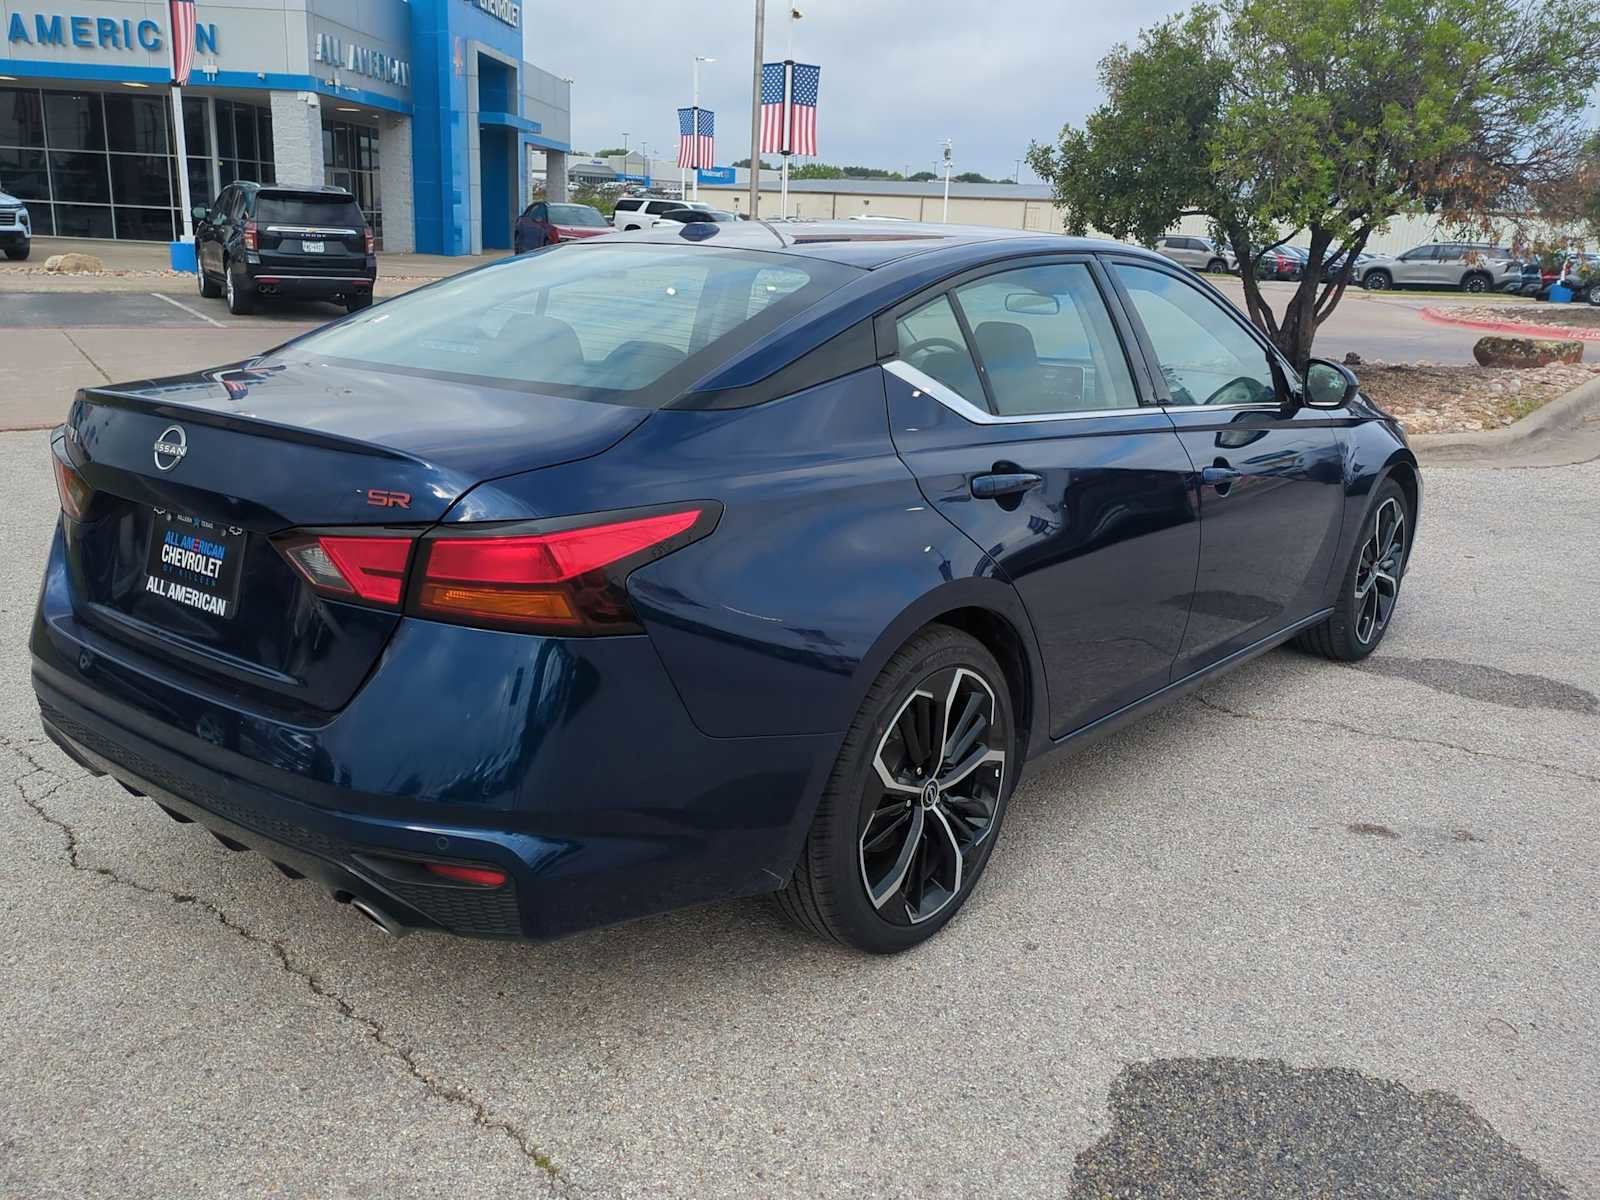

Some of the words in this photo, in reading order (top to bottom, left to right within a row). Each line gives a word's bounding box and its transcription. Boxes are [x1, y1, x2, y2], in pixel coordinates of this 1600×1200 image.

[9, 13, 218, 54] AMERICN
[314, 33, 343, 66] ALL
[154, 441, 188, 457] NISSAN
[368, 489, 411, 509] SR
[161, 544, 223, 578] CHEVROLET
[164, 531, 180, 547] ALL
[180, 535, 225, 559] AMERICAN
[146, 576, 166, 596] ALL
[167, 583, 227, 616] AMERICAN
